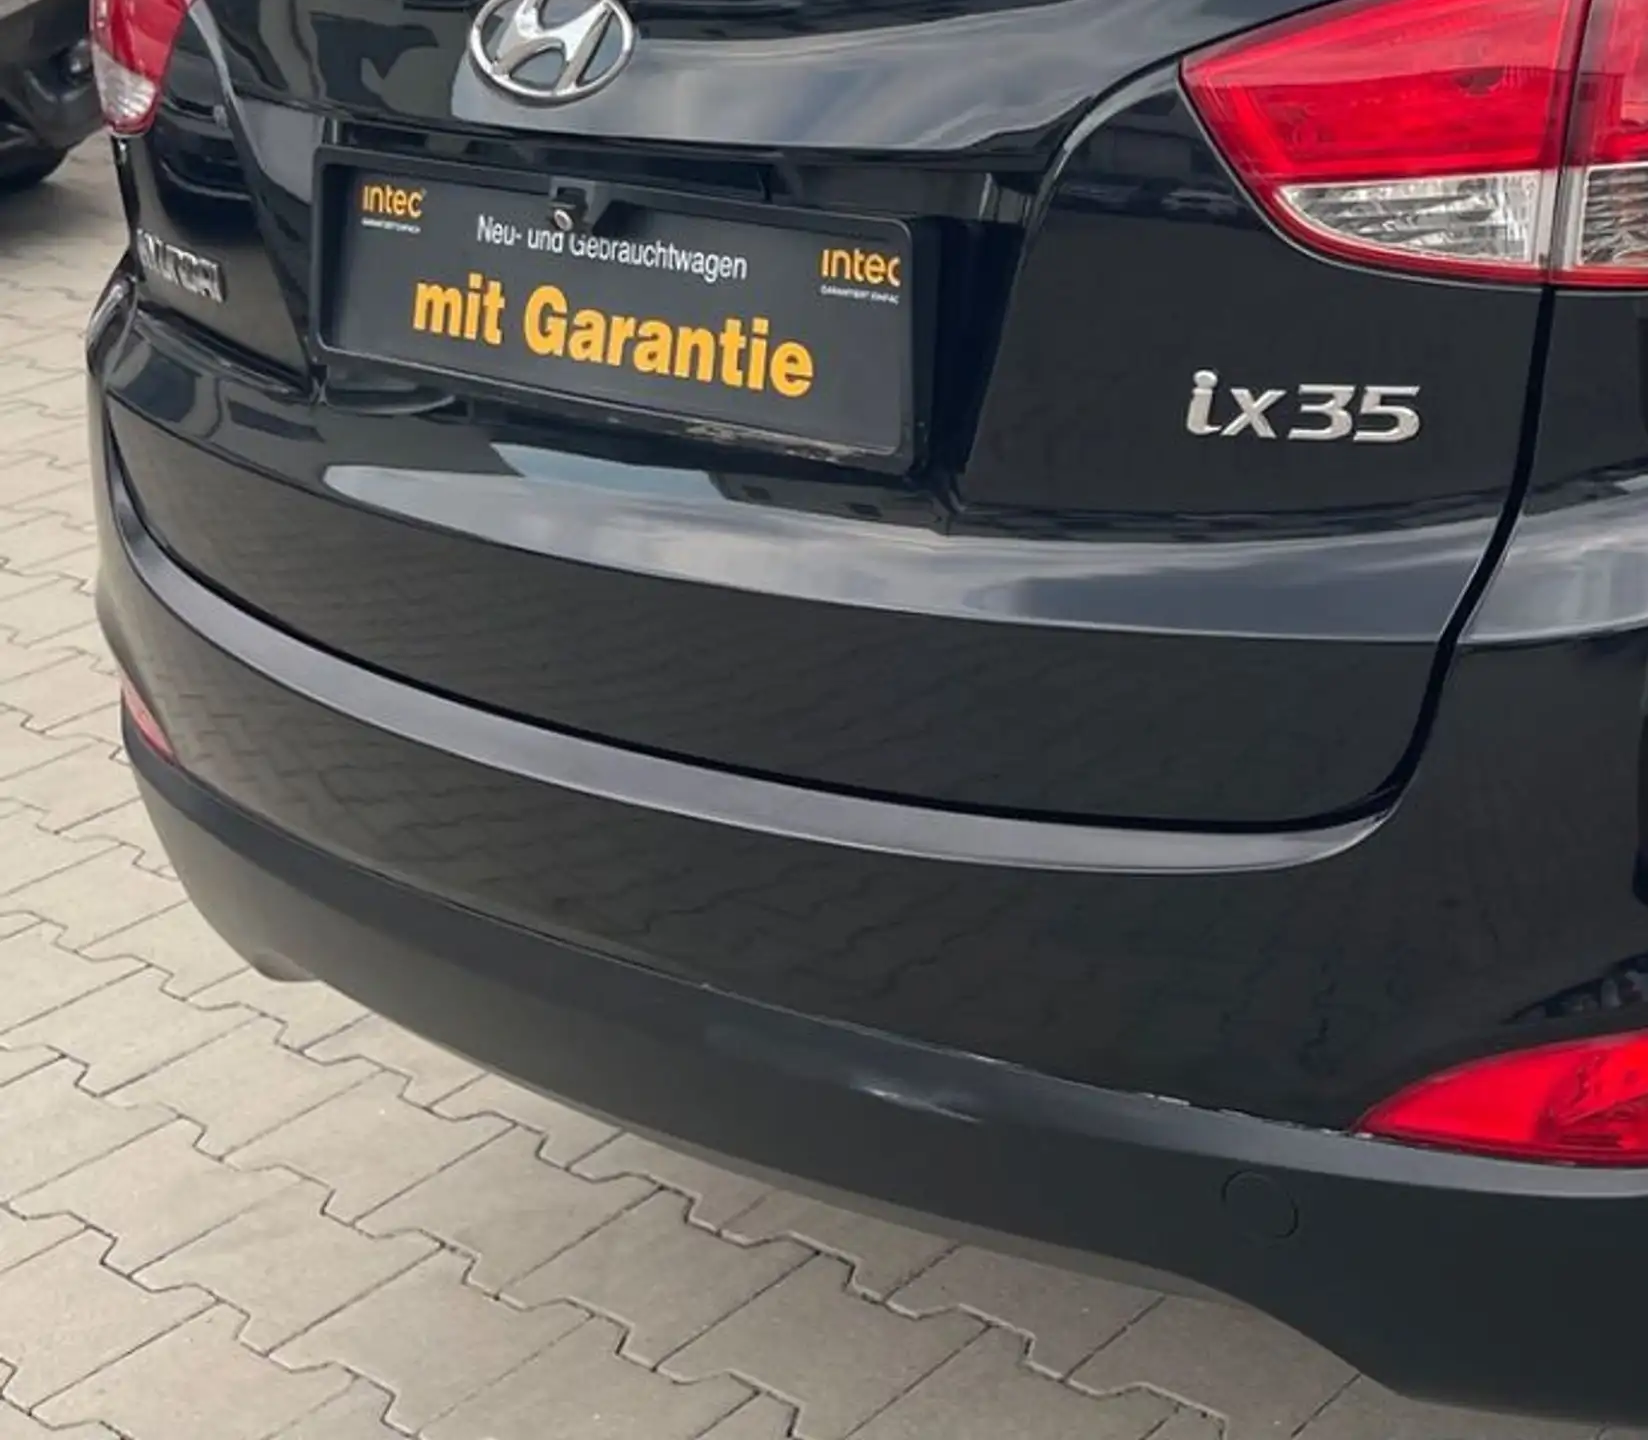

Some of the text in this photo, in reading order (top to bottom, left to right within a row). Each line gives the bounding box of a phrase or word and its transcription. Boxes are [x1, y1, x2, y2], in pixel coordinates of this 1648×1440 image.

[362, 184, 423, 218] intec
[477, 214, 748, 283] Neu- und Gebrauchtwagen
[822, 247, 901, 288] intec
[413, 272, 814, 398] mit Garantie
[1186, 369, 1421, 443] ix35
